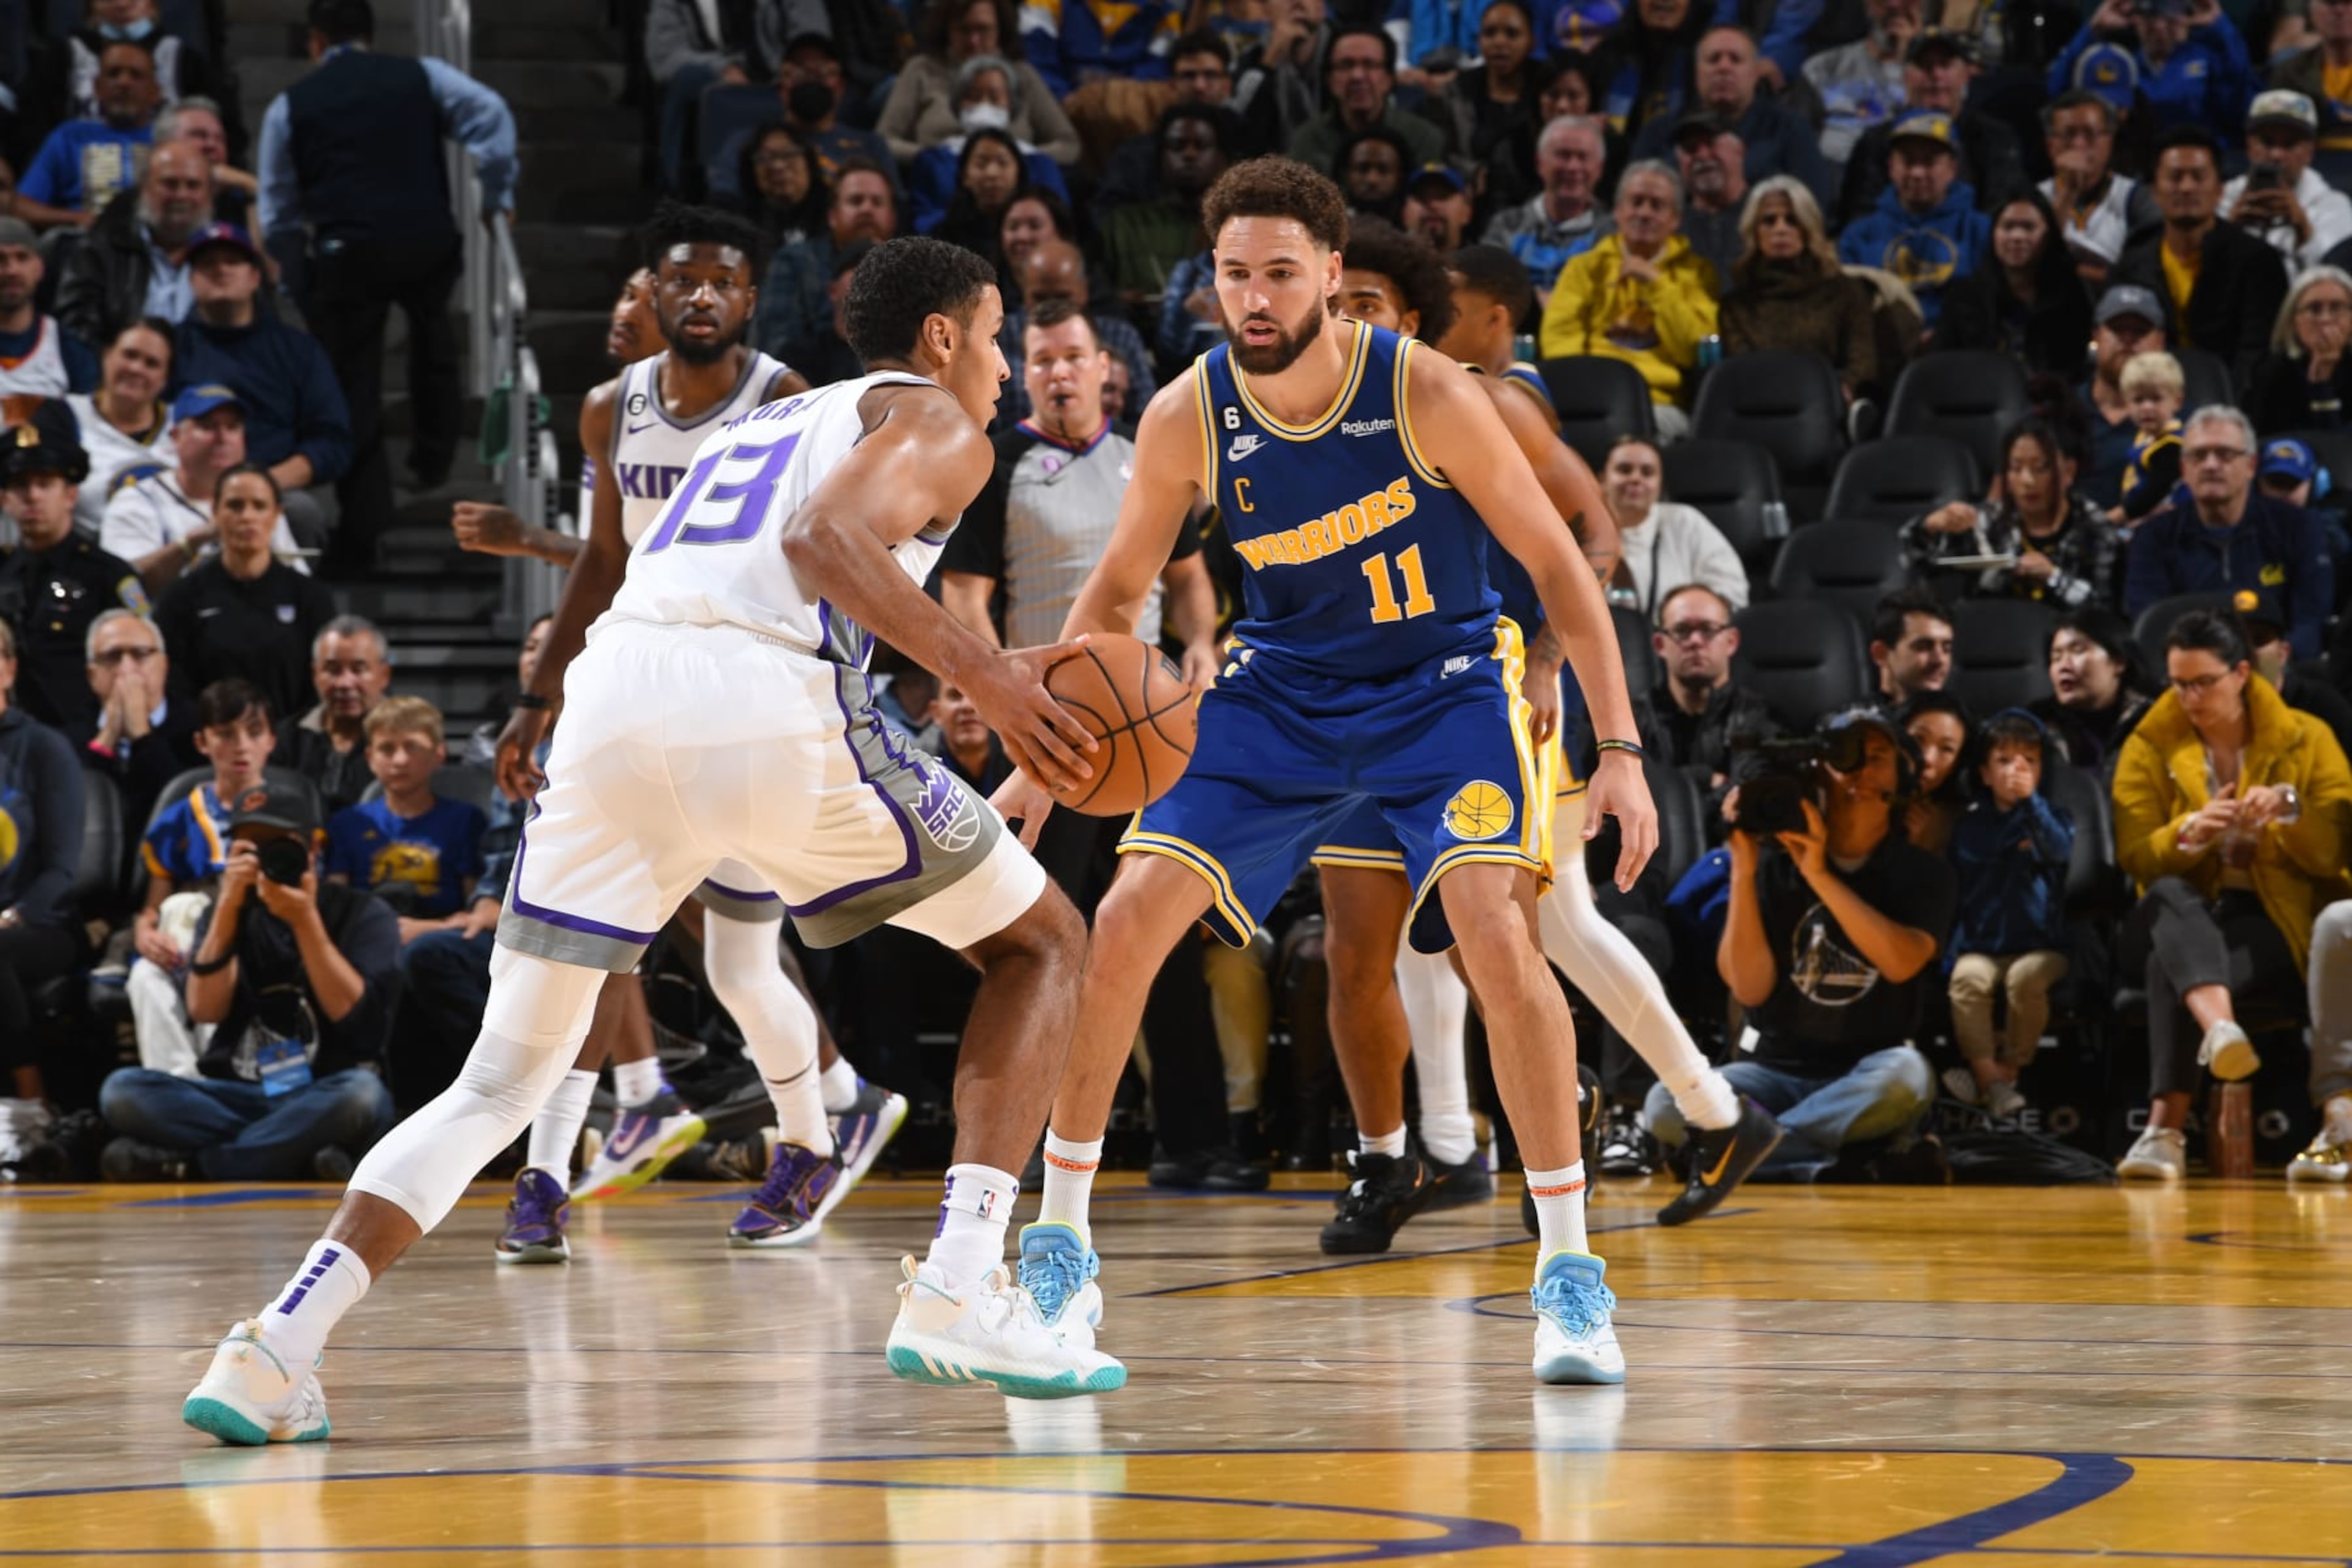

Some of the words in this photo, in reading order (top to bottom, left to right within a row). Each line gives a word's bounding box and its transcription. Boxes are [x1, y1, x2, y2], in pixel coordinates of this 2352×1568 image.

[629, 395, 647, 416] 6
[1223, 407, 1242, 430] 6
[1341, 418, 1396, 435] Rakuten
[1233, 434, 1260, 451] NIKE
[641, 429, 803, 556] 13
[1234, 477, 1255, 513] C
[1232, 475, 1416, 571] WARRIORS
[1361, 543, 1436, 624] 11
[1444, 655, 1470, 674] NIKE
[926, 784, 967, 838] SAC
